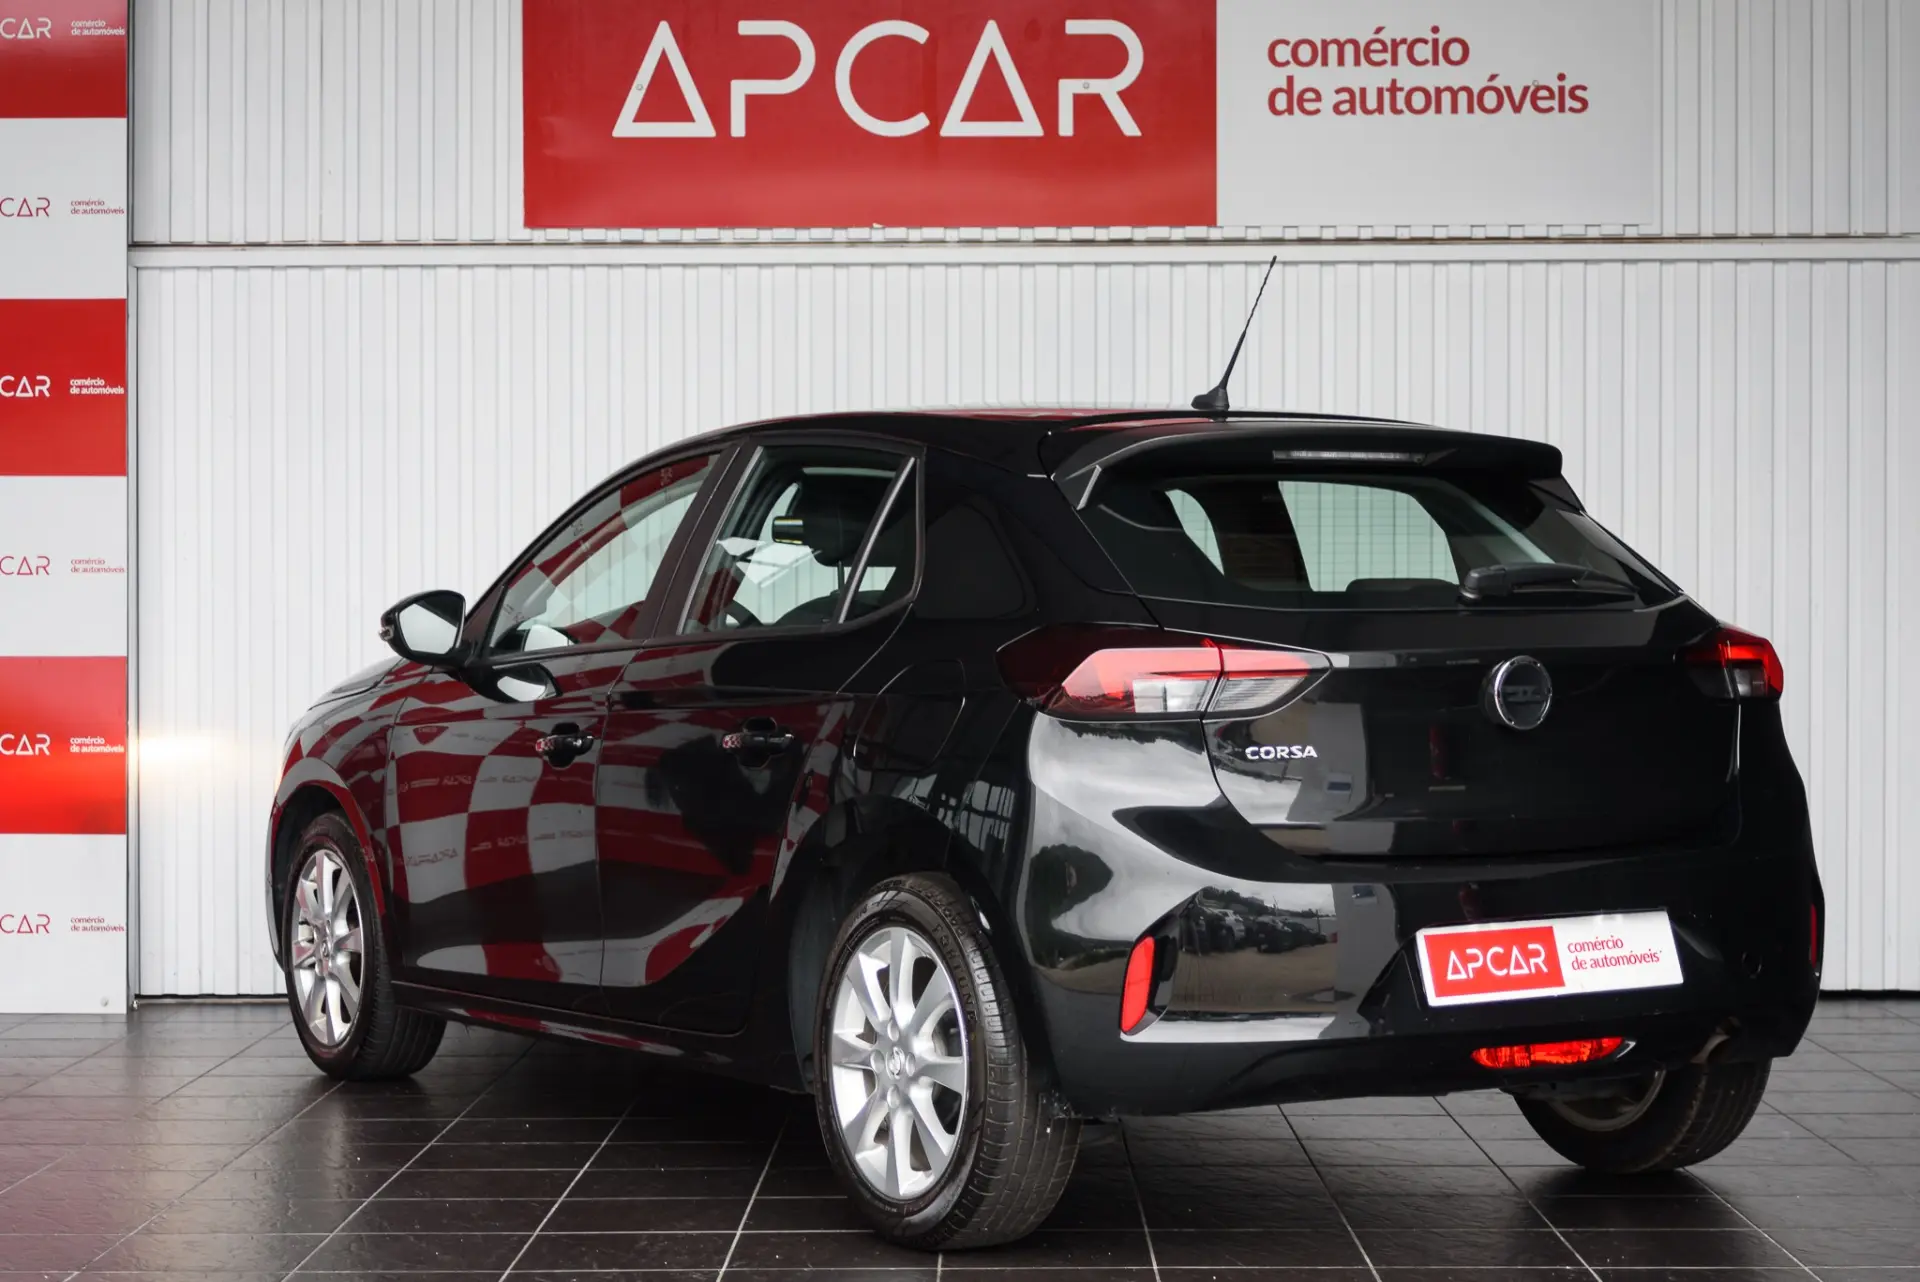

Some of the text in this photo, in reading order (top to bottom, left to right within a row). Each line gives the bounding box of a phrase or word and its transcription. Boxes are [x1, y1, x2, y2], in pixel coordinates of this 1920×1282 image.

[71, 27, 81, 36] de
[1267, 25, 1470, 68] comércio
[611, 19, 1144, 137] APCAR
[1268, 73, 1589, 116] de automóveis
[70, 197, 105, 207] comércio
[70, 206, 124, 215] de automóveis
[70, 385, 80, 395] de
[70, 565, 80, 574] de
[70, 744, 80, 753] de
[1245, 745, 1318, 760] CORSA
[70, 924, 80, 932] de
[1567, 934, 1624, 954] comércio
[1446, 943, 1548, 981] APCAR
[1571, 947, 1660, 971] de automóveis
